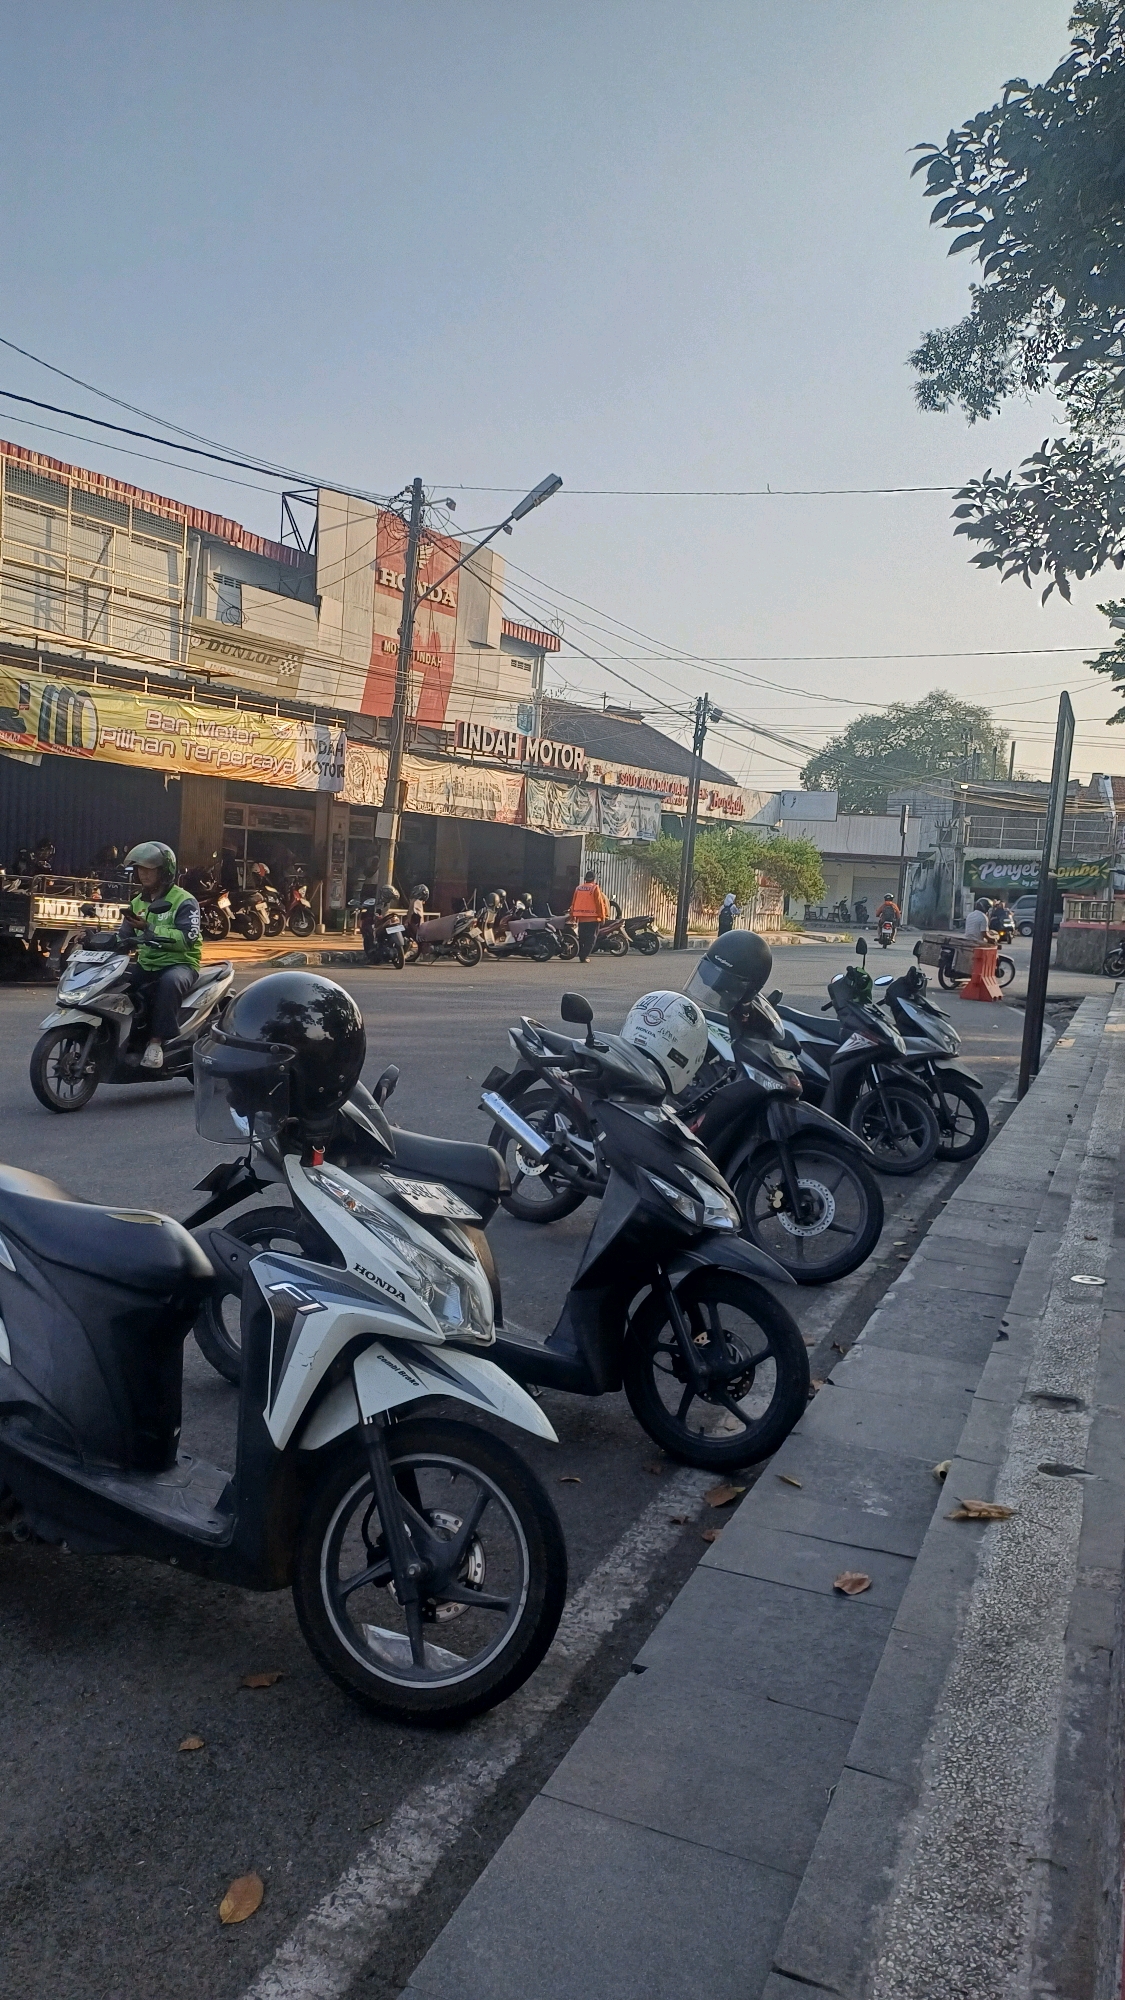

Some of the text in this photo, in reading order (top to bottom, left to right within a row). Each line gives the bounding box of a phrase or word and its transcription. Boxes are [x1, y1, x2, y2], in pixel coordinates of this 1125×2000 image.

[205, 638, 280, 666] DUNLOP
[145, 709, 261, 746] Ban Motor
[99, 726, 296, 776] Pilihan Terpercaya
[304, 738, 344, 757] INDAH
[463, 721, 585, 771] INDAH MOTOR
[301, 761, 346, 779] MOTOR
[979, 860, 1040, 880] Penyet
[353, 1262, 407, 1303] HONDA
[376, 1354, 420, 1387] Combi Brake
